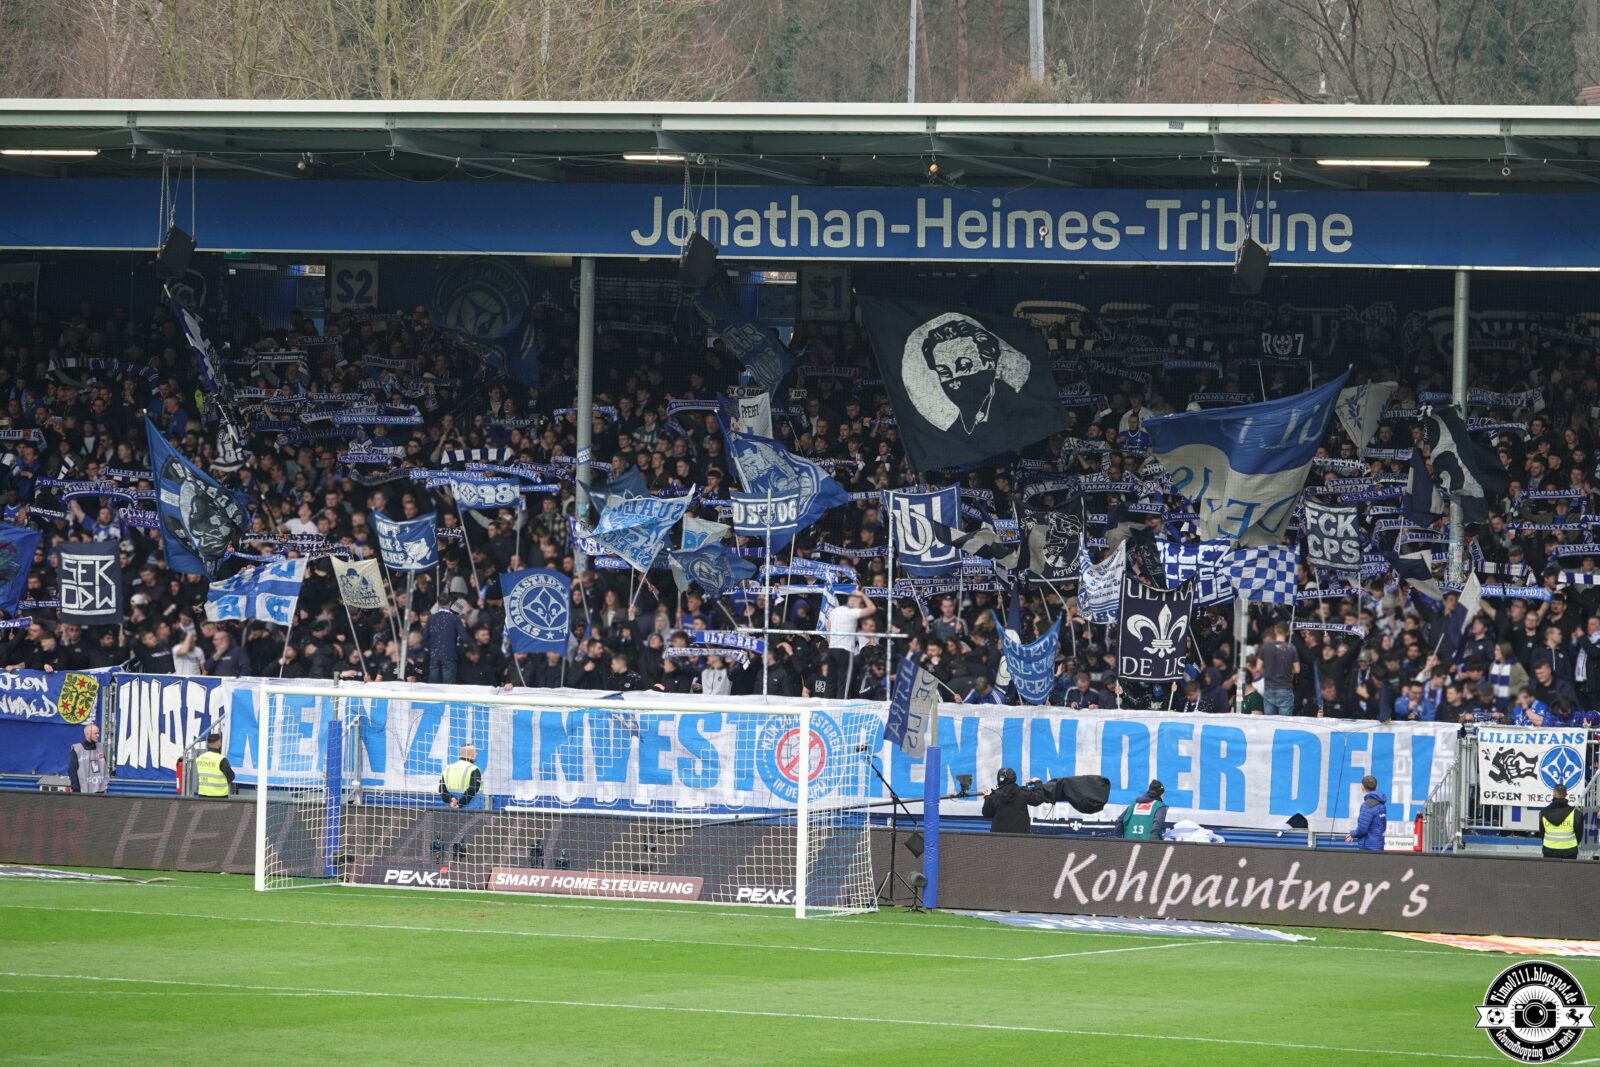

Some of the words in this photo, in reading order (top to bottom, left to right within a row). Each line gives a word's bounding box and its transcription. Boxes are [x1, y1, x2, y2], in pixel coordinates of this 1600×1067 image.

[630, 194, 1353, 254] Jonathan-Heimes-Tribüne
[335, 269, 372, 304] S2
[313, 393, 361, 401] DARMSTADT
[1081, 484, 1132, 492] DARMSTADT
[1529, 488, 1581, 498] DARMSTADT
[778, 501, 797, 523] 06
[1305, 507, 1358, 538] FCK
[1307, 534, 1360, 564] CPS
[935, 583, 989, 593] DARMSTADT
[1296, 588, 1347, 598] ARMSTADT
[1121, 656, 1153, 678] DE
[1479, 731, 1585, 746] LILIENFANS
[1001, 717, 1078, 802] IN
[1101, 720, 1248, 813] DER
[1483, 790, 1522, 802] GEGEN
[1132, 825, 1144, 834] 13
[384, 868, 437, 886] PEAK
[495, 872, 549, 888] SMART
[551, 876, 598, 891] HOME
[599, 878, 694, 896] STEUERUNG
[736, 888, 795, 904] PEAK
